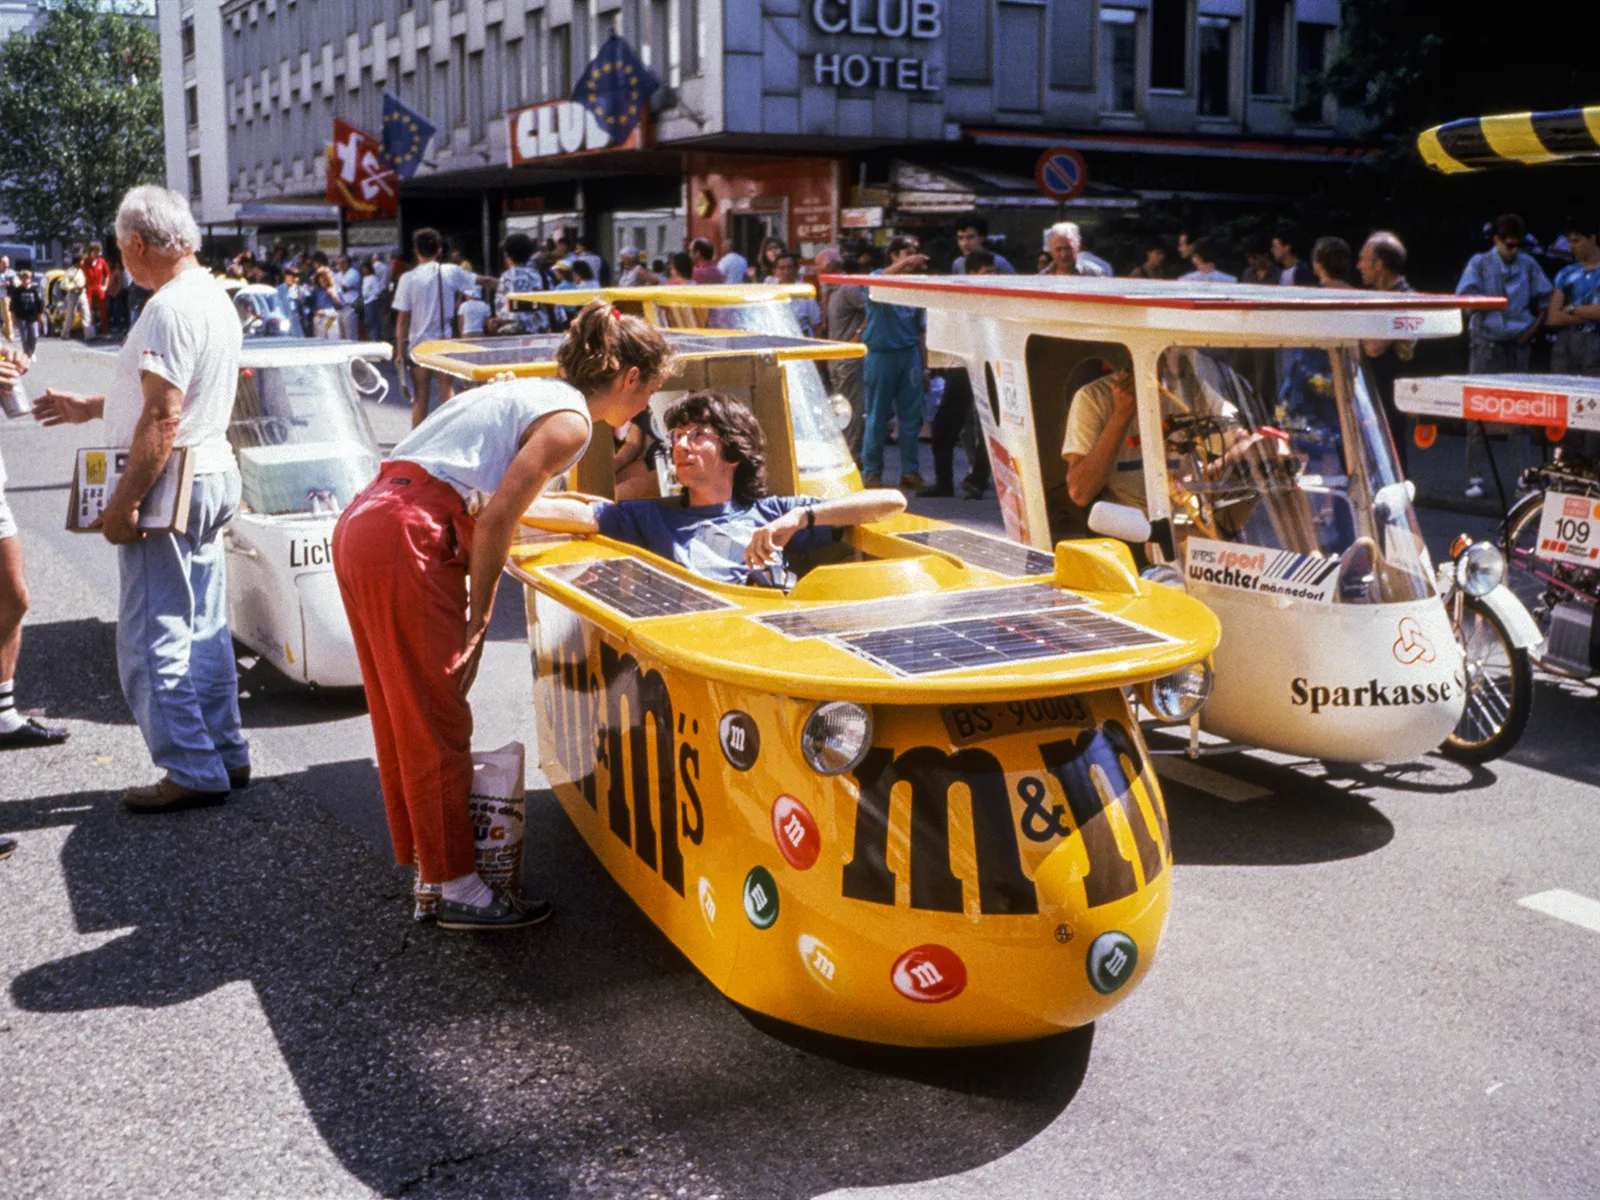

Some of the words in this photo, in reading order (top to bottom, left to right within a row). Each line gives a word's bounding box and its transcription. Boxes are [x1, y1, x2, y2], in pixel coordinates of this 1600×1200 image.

[813, 0, 942, 38] CLUB
[814, 53, 940, 90] HOTEL
[1470, 394, 1558, 419] sopedil
[1555, 517, 1591, 544] 109
[1218, 550, 1268, 574] sport
[1189, 563, 1259, 591] wachter
[1291, 677, 1451, 714] Sparkasse
[951, 704, 994, 739] BS
[730, 725, 746, 751] m
[784, 814, 806, 848] m
[751, 883, 768, 912] m
[813, 951, 836, 981] m
[911, 961, 944, 989] m
[1104, 946, 1128, 977] m
